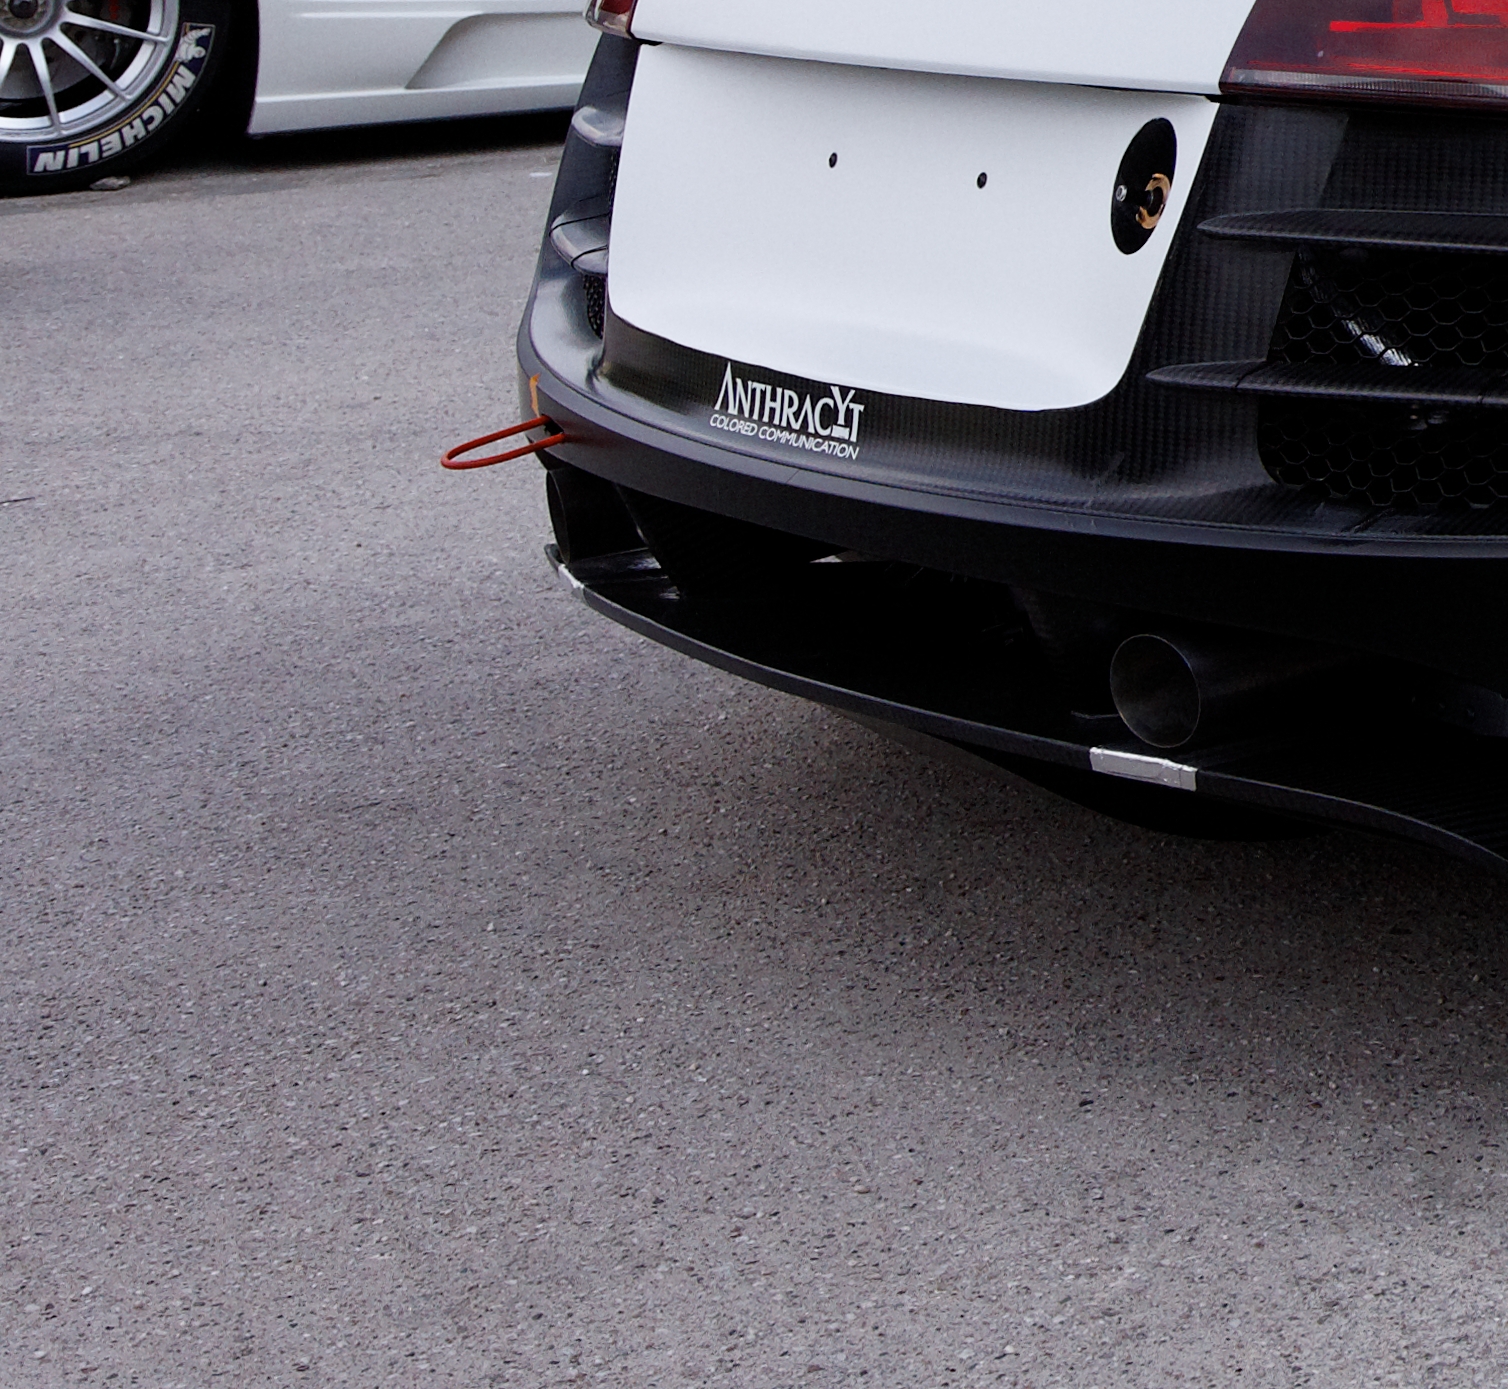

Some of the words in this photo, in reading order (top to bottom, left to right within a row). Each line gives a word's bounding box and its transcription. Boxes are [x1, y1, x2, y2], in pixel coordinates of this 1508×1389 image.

[32, 64, 196, 173] MICHELIN
[710, 413, 759, 437] COLORED
[758, 426, 860, 460] COMMUNICATION
[714, 361, 865, 443] ANTHRACYT
